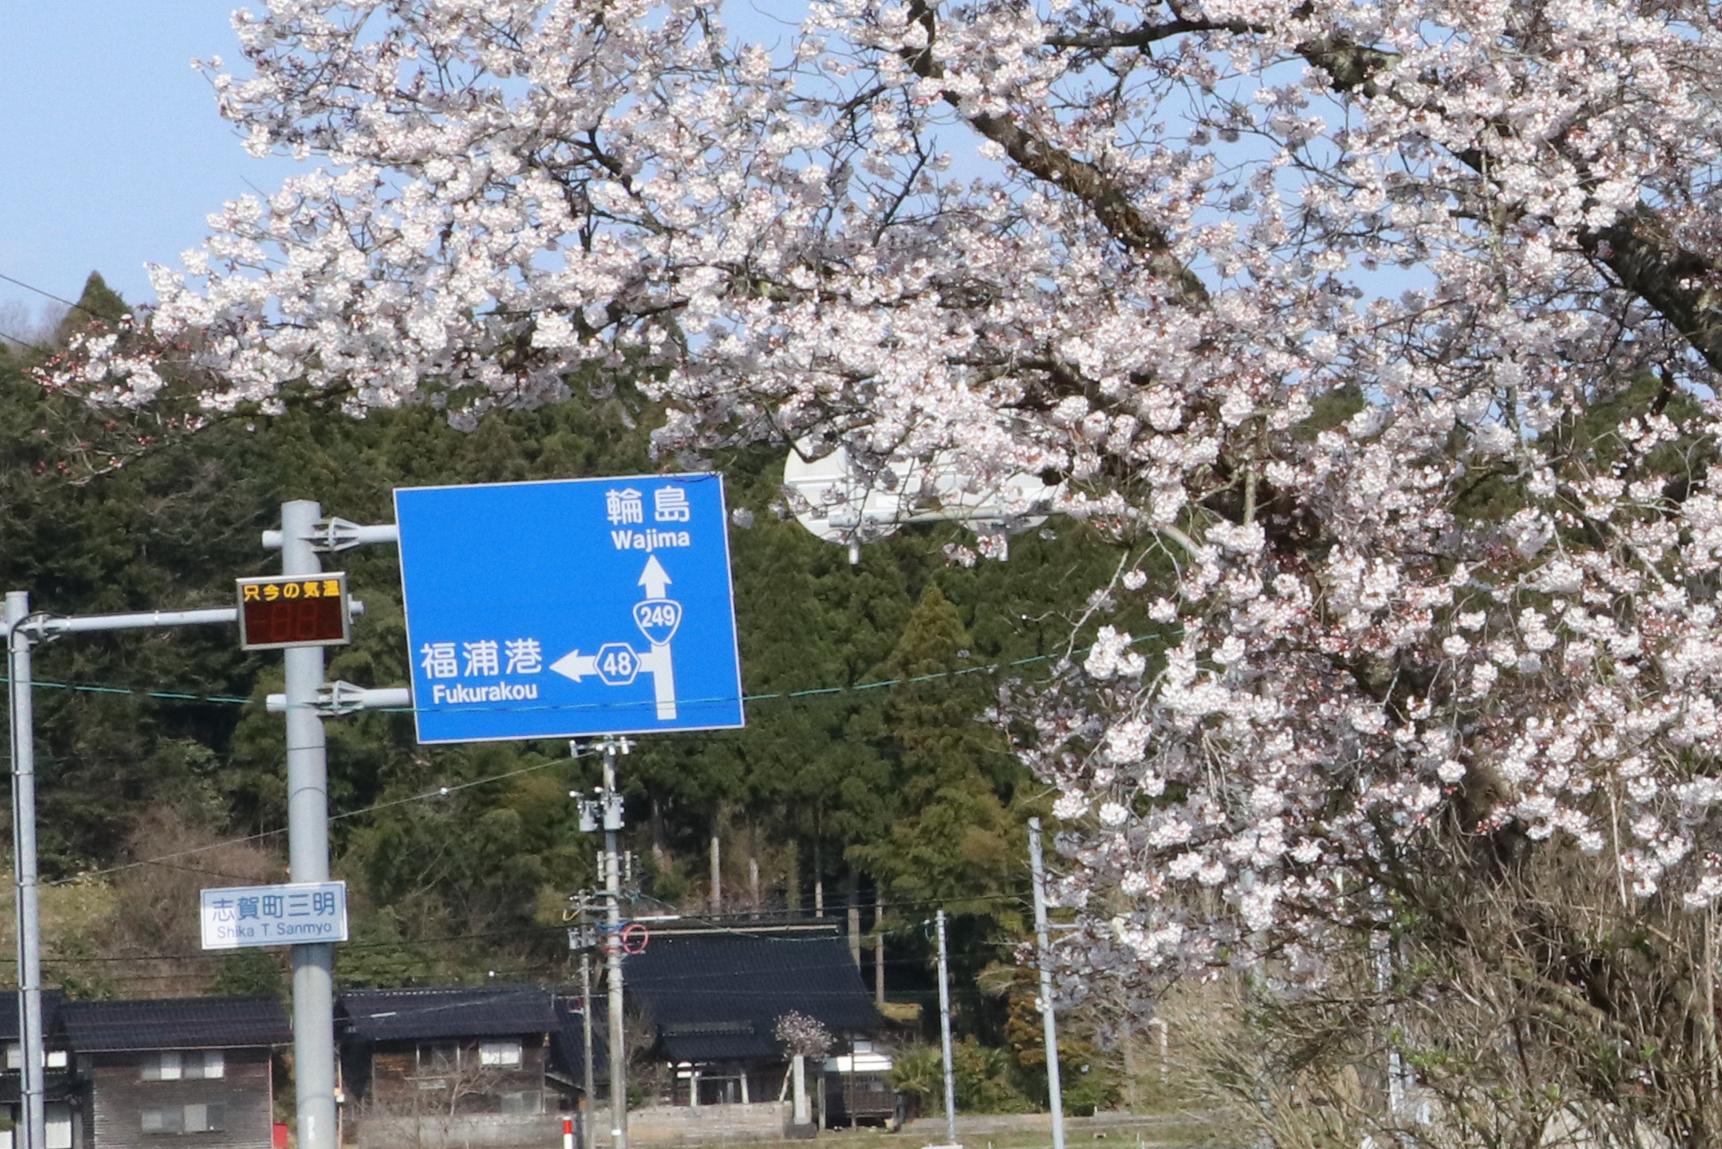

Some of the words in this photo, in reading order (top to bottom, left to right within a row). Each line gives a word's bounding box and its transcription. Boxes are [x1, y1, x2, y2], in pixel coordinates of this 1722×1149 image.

[605, 485, 692, 526] 輪島
[611, 528, 691, 552] Wajima
[243, 580, 340, 602] 只今の気温
[640, 605, 676, 628] 249
[420, 637, 543, 679] 福浦港
[603, 652, 632, 676] 48
[432, 681, 538, 704] Fukurakou
[212, 891, 335, 922] 志賀町三明
[217, 926, 255, 939] Shika
[277, 922, 332, 935] Sanmyo
